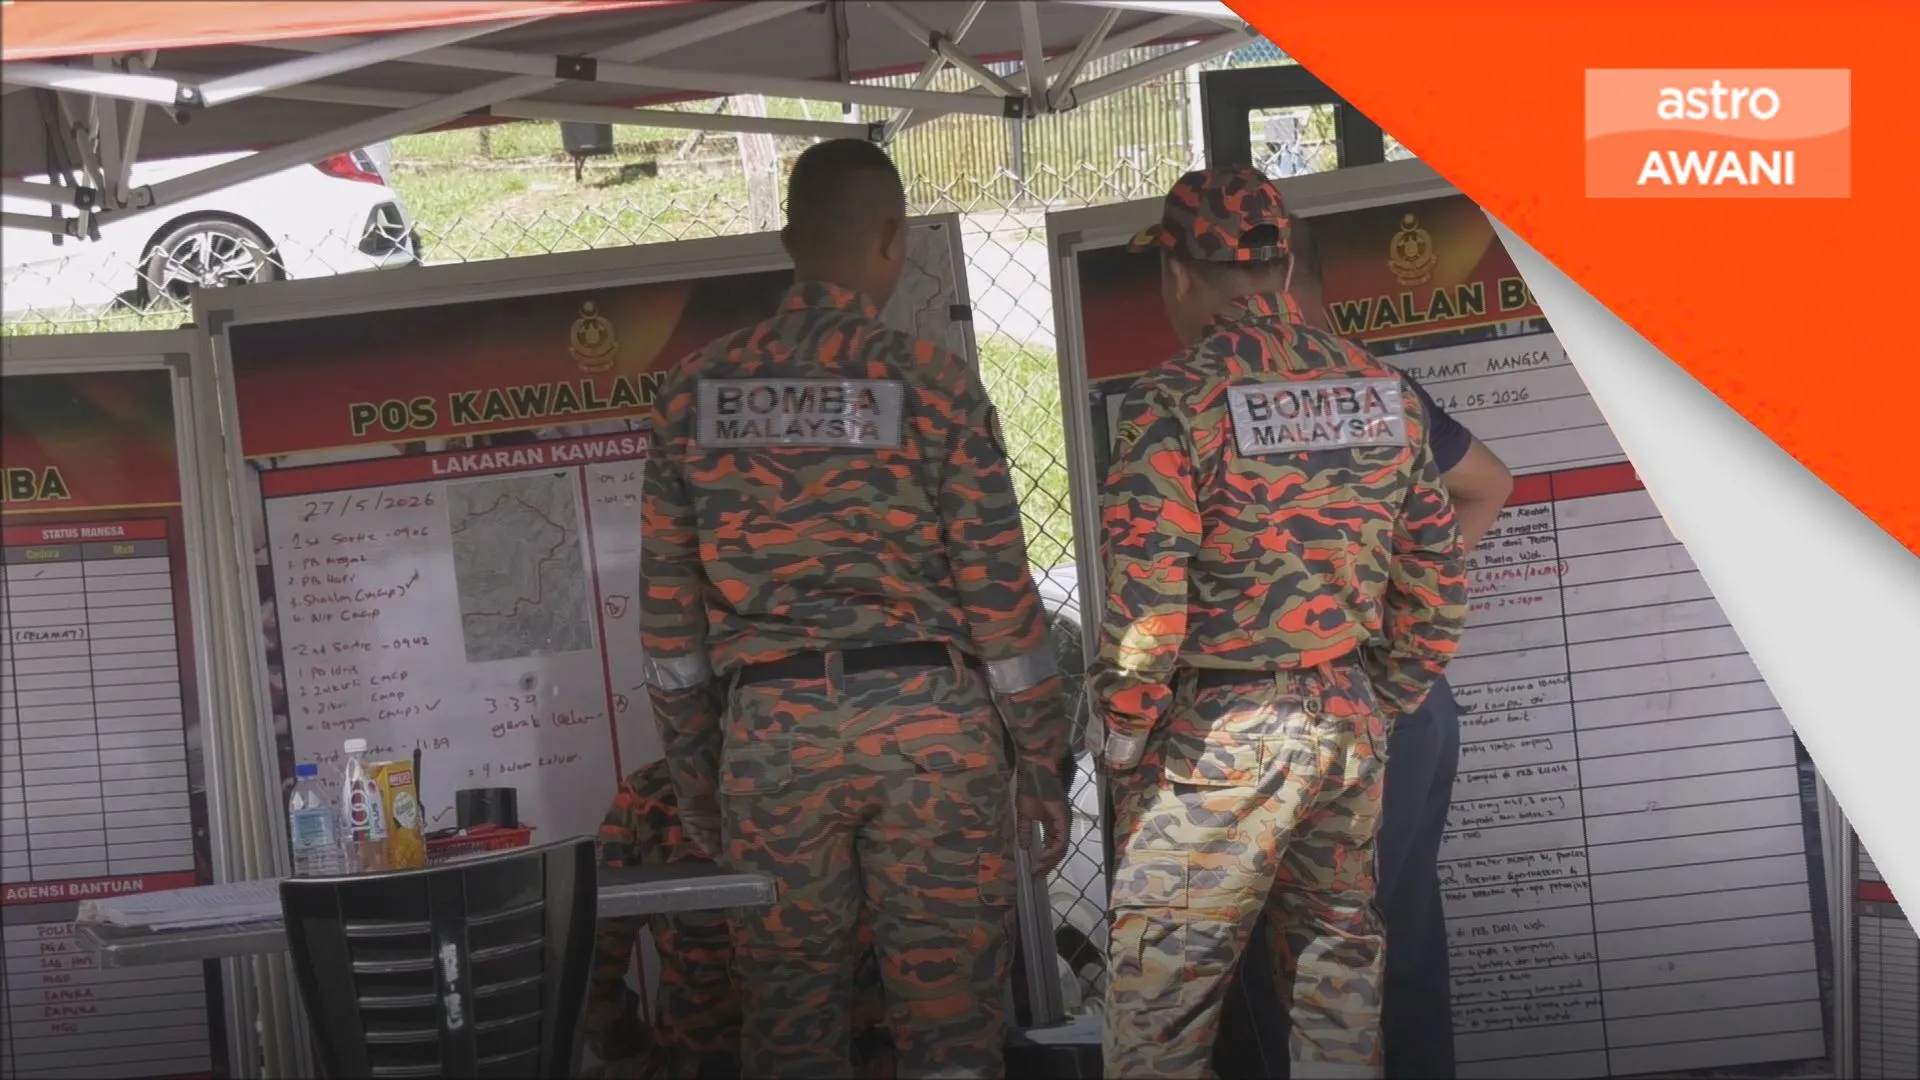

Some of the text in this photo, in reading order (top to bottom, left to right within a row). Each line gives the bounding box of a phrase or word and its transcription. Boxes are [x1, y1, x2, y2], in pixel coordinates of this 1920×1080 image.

[1324, 276, 1538, 335] WALAN B
[1487, 351, 1549, 372] MANGSA
[351, 370, 667, 436] POS KAWALAN
[716, 385, 880, 416] BOMBA
[1245, 386, 1389, 422] BOMBA
[715, 418, 880, 441] MALAYSIA
[1252, 418, 1393, 446] MALAYSIA
[432, 437, 649, 475] LAKARAN KAWASA
[1, 465, 72, 504] BA
[42, 525, 125, 540] STATUS MANGSA
[7, 879, 143, 900] AGENSI BANTUAN
